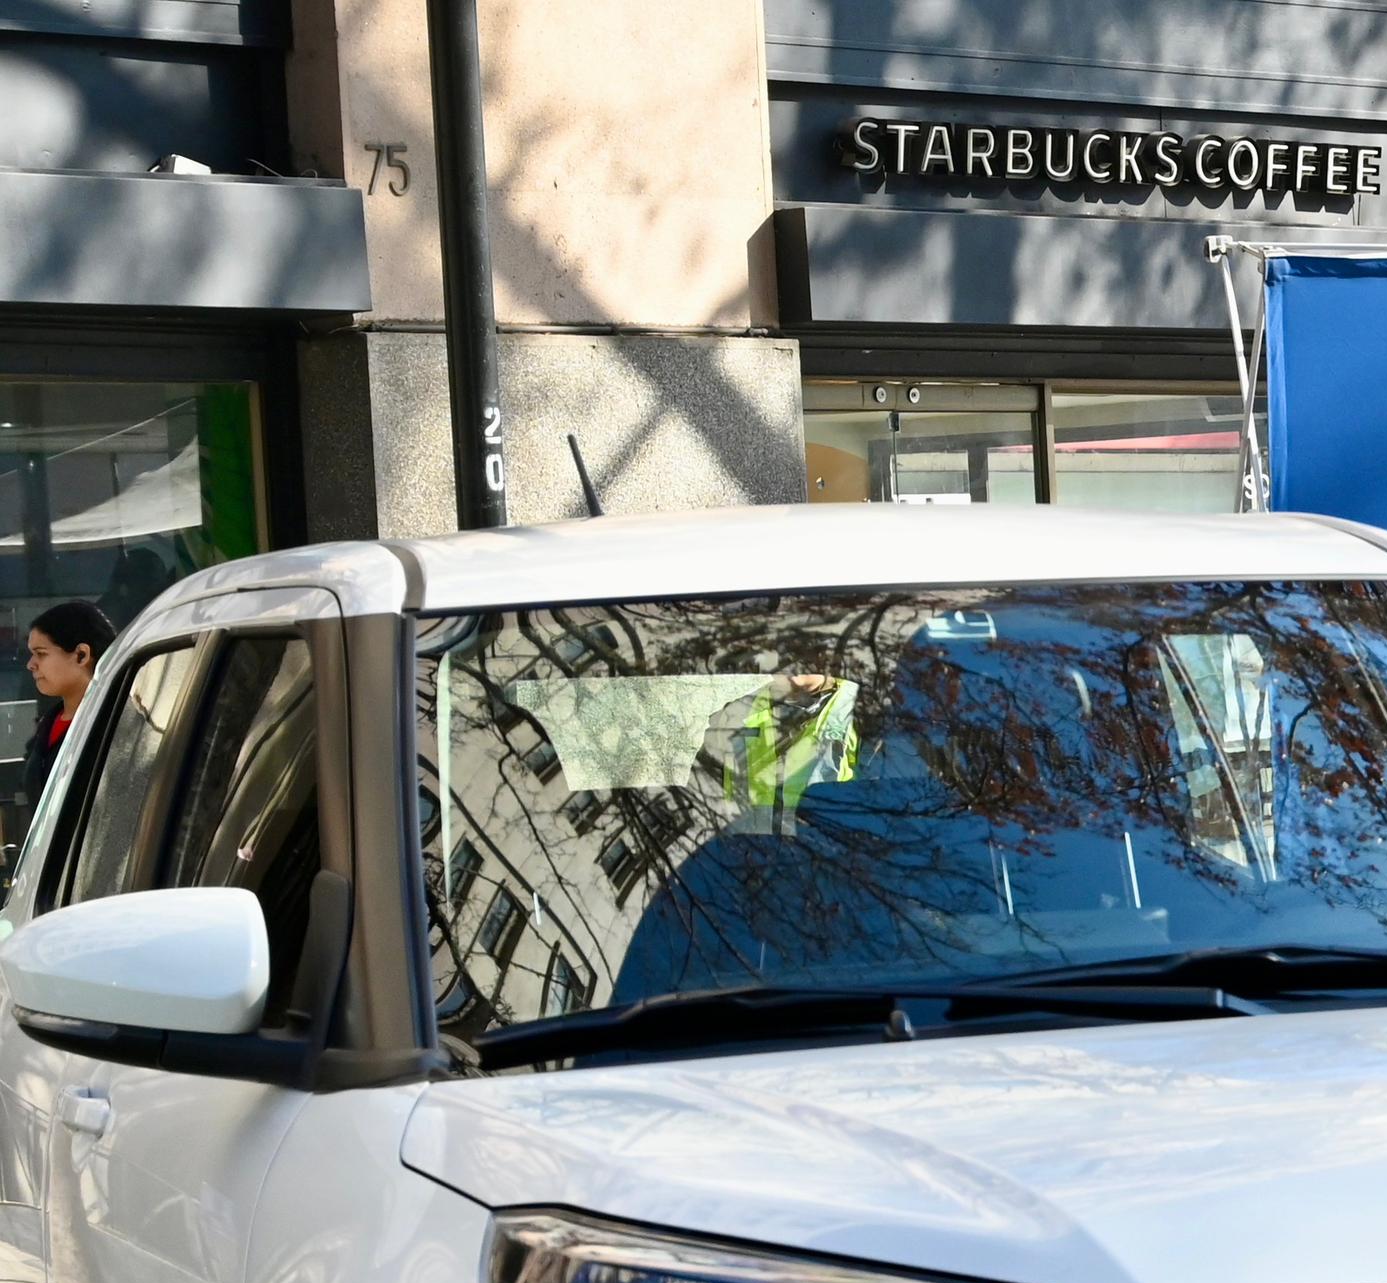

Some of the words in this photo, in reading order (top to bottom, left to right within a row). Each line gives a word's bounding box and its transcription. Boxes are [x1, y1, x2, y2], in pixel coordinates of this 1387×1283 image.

[364, 143, 411, 197] 75
[853, 121, 1184, 185] STARBUCKS
[1195, 134, 1382, 195] COFFEE
[483, 406, 505, 491] 20
